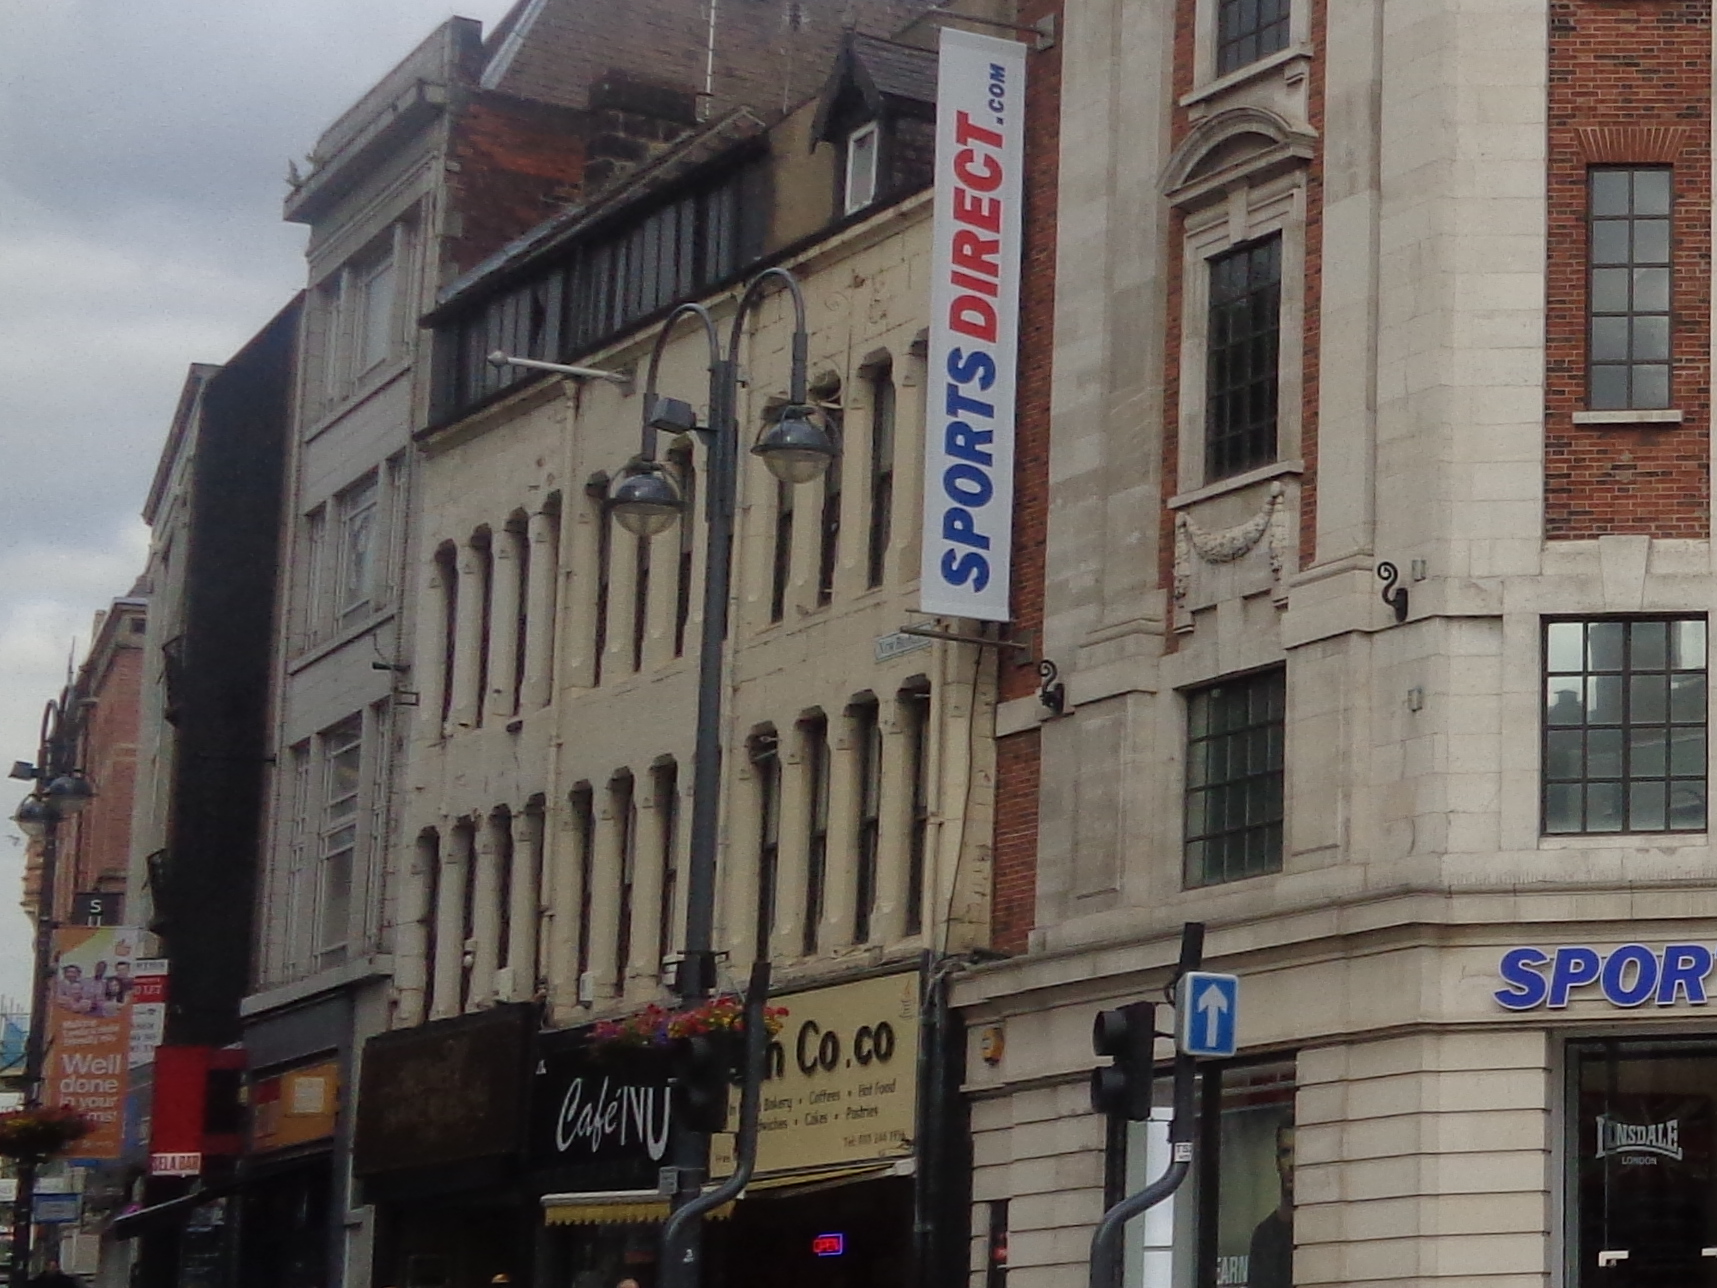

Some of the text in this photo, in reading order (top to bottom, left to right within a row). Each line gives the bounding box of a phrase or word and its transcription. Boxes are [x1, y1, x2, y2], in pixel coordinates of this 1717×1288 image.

[62, 1054, 121, 1076] Well
[60, 1076, 119, 1094] done
[1595, 1116, 1682, 1160] LONSDALE
[1621, 1156, 1657, 1165] LONDON
